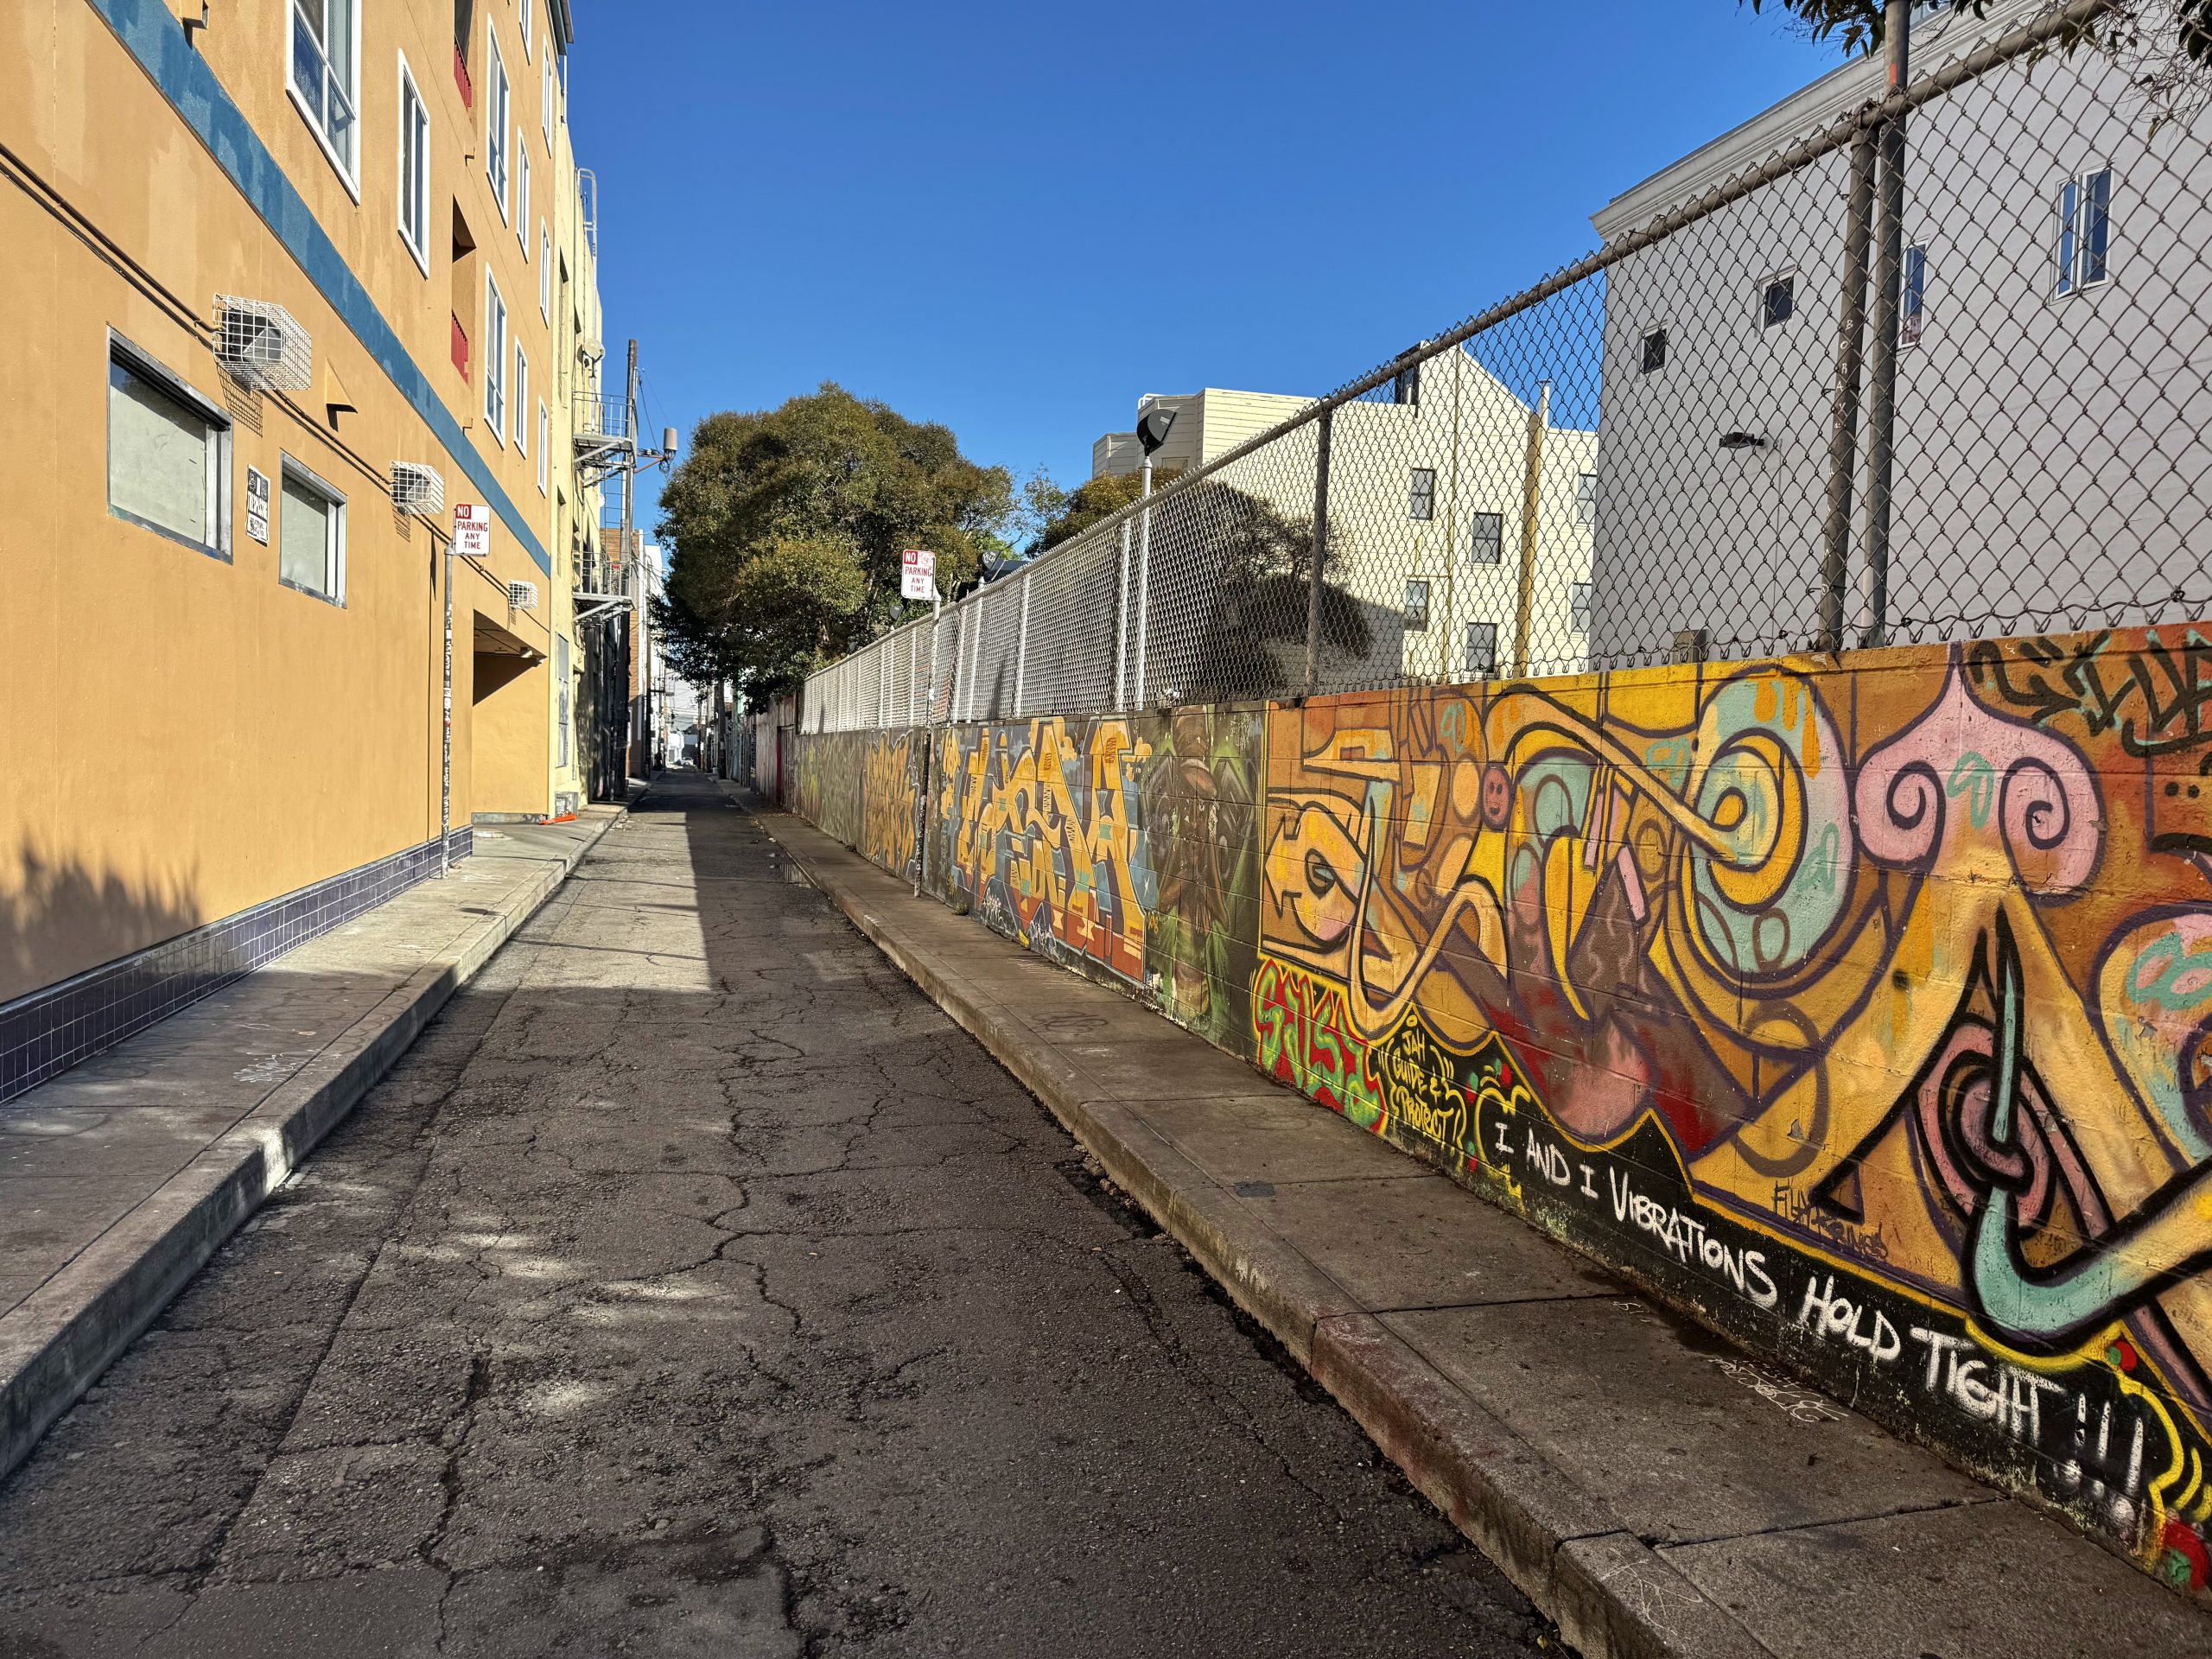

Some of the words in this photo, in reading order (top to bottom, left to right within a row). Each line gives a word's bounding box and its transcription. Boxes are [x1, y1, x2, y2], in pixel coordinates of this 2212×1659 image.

[457, 505, 470, 518] NO
[457, 520, 488, 532] PARKING
[465, 532, 480, 541] ANY
[464, 541, 481, 550] TIME
[906, 551, 917, 563] NO
[905, 566, 932, 577] PARKING
[911, 576, 925, 585] ANY
[910, 585, 925, 594] TIME
[1402, 1027, 1426, 1064] JAH
[1392, 1046, 1428, 1096] GUIDE
[1494, 1121, 1514, 1154] I
[1526, 1124, 1571, 1186] AND
[1579, 1163, 1599, 1200] I
[1609, 1165, 1777, 1308] VIBRATIONS
[1798, 1274, 1901, 1363] HOLD
